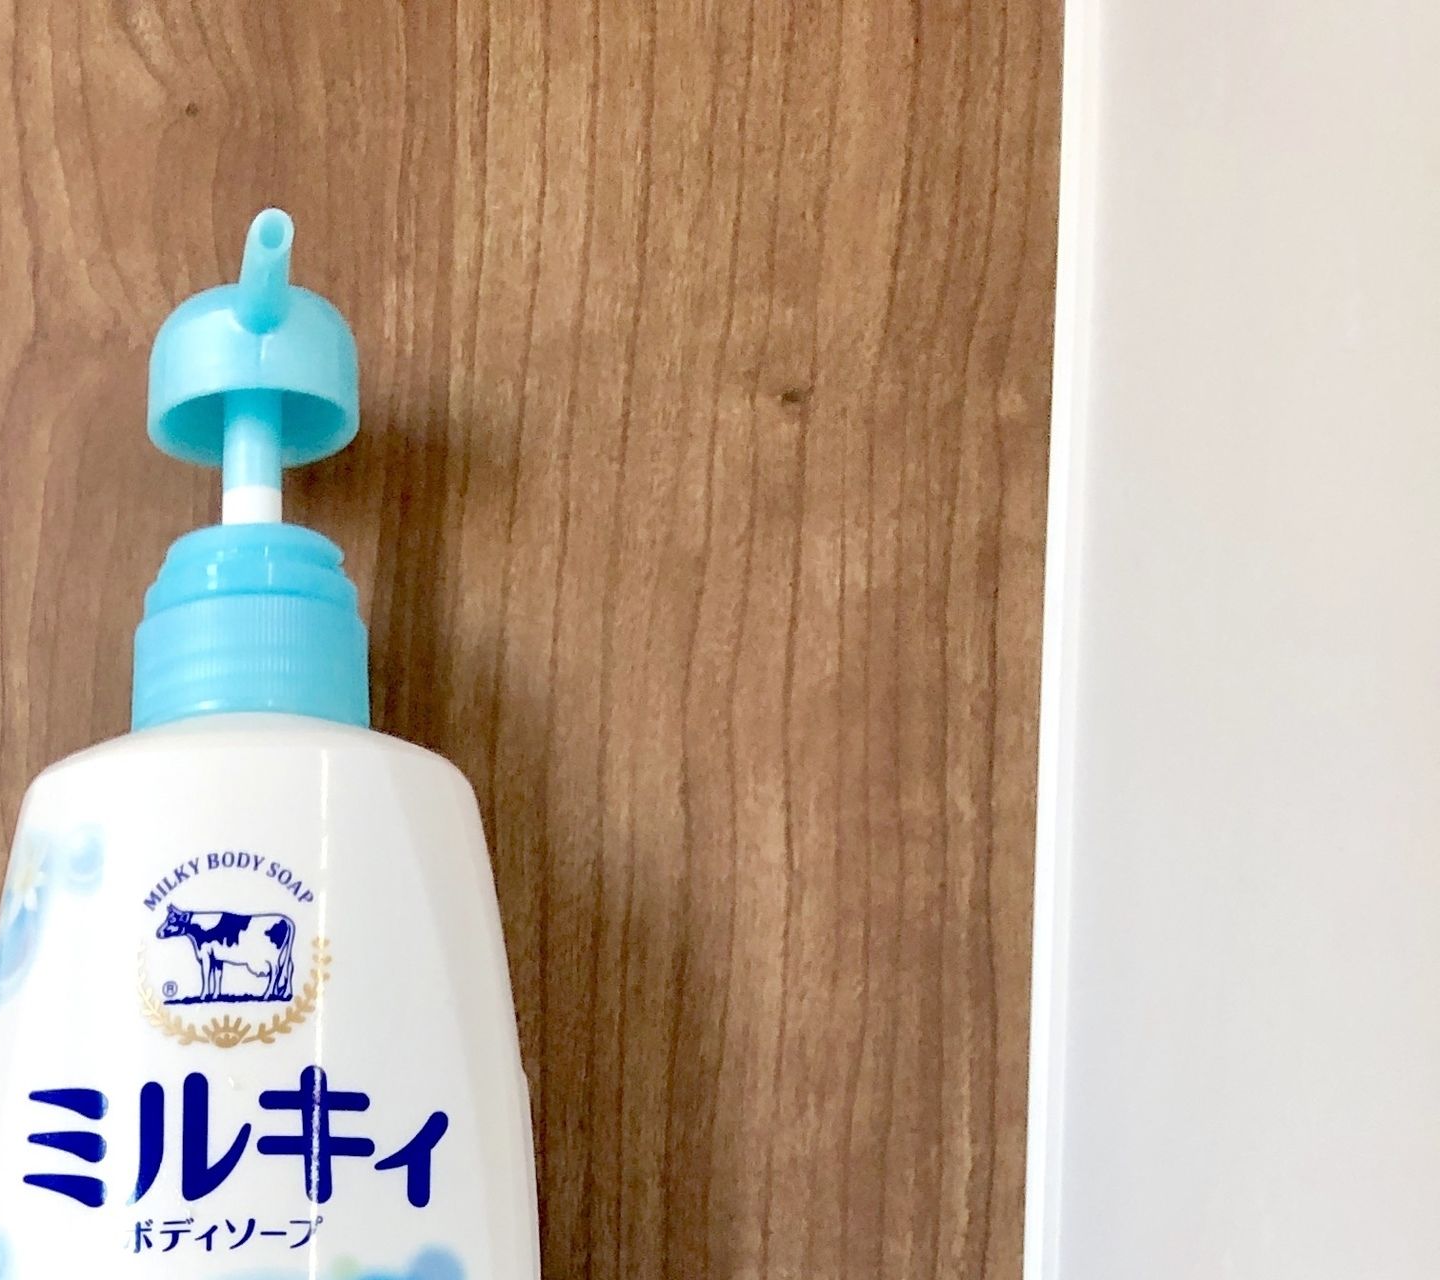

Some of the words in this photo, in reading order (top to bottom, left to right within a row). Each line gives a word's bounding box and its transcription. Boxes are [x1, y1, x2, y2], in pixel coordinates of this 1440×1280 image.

[143, 857, 200, 912] MILKY
[207, 851, 265, 872] BODY
[266, 862, 314, 904] SOAP
[23, 1064, 449, 1208] ミルキィ
[125, 1215, 324, 1254] ボディソープ
